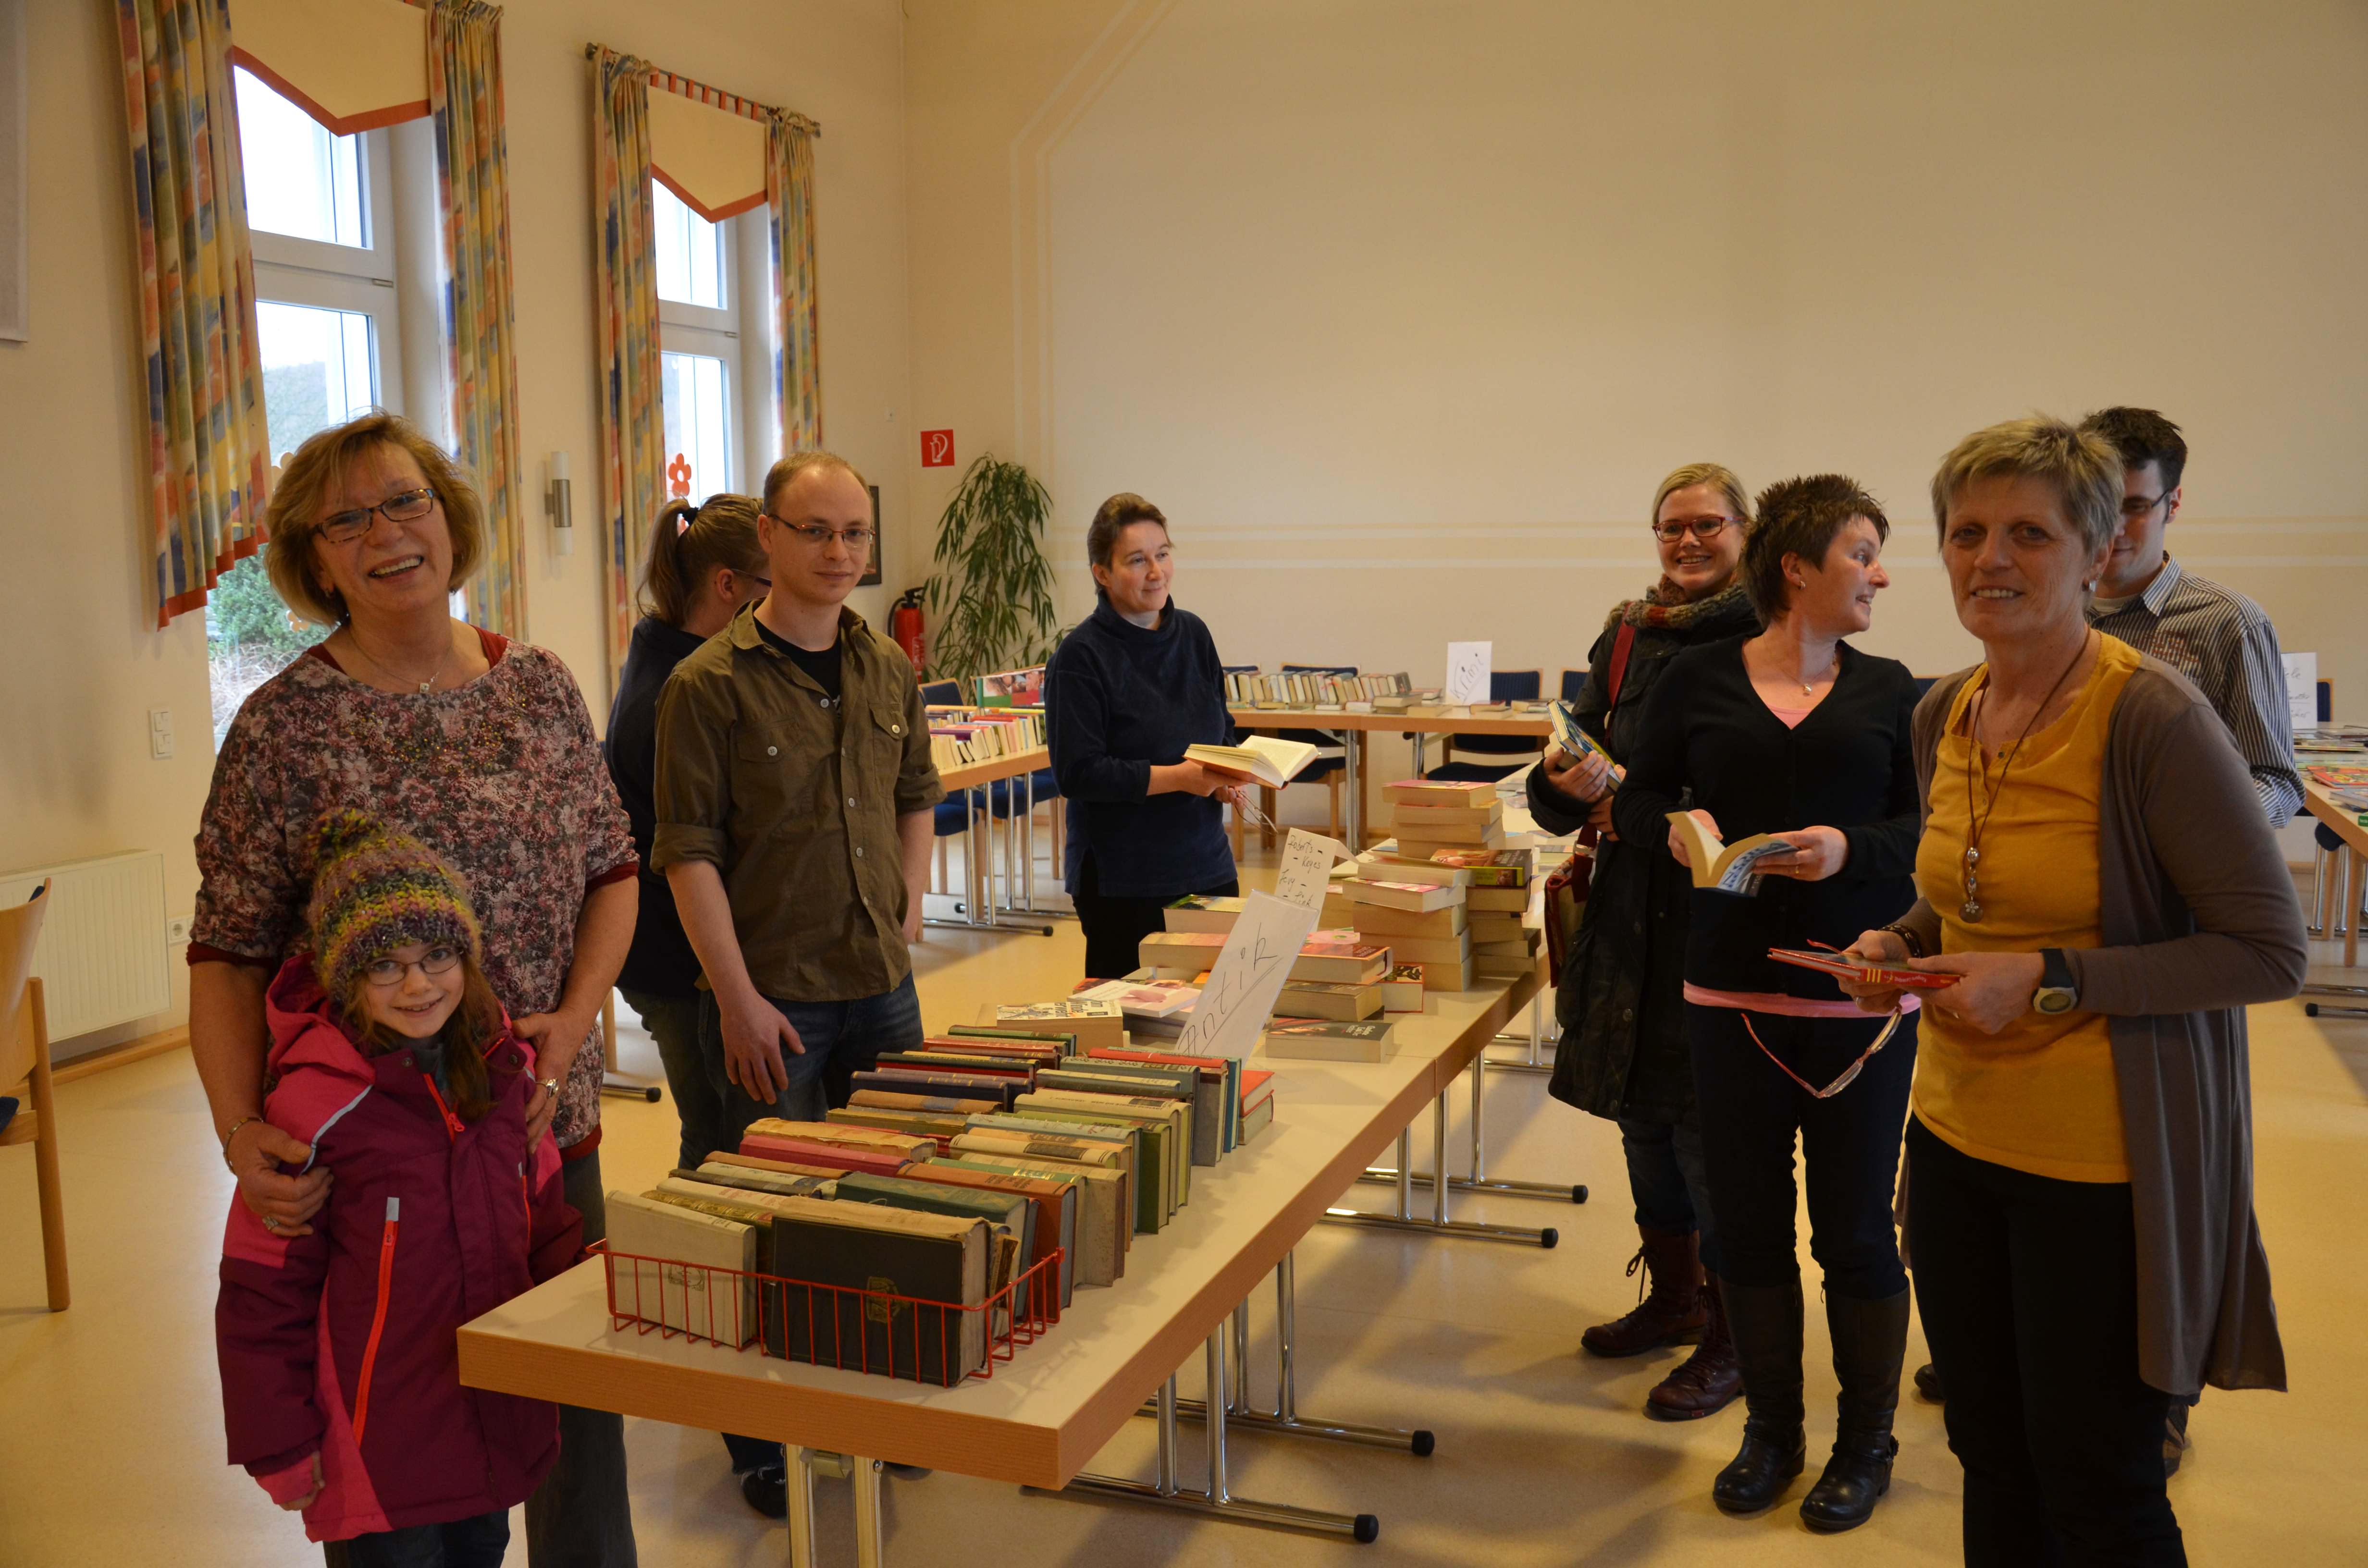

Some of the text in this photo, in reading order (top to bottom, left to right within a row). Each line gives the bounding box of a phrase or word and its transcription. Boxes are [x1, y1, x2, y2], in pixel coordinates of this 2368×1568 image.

[1450, 652, 1484, 698] Krimi
[1288, 835, 1313, 853] Roberts
[1302, 856, 1320, 873] Keyes
[1178, 922, 1278, 1055] Antik
